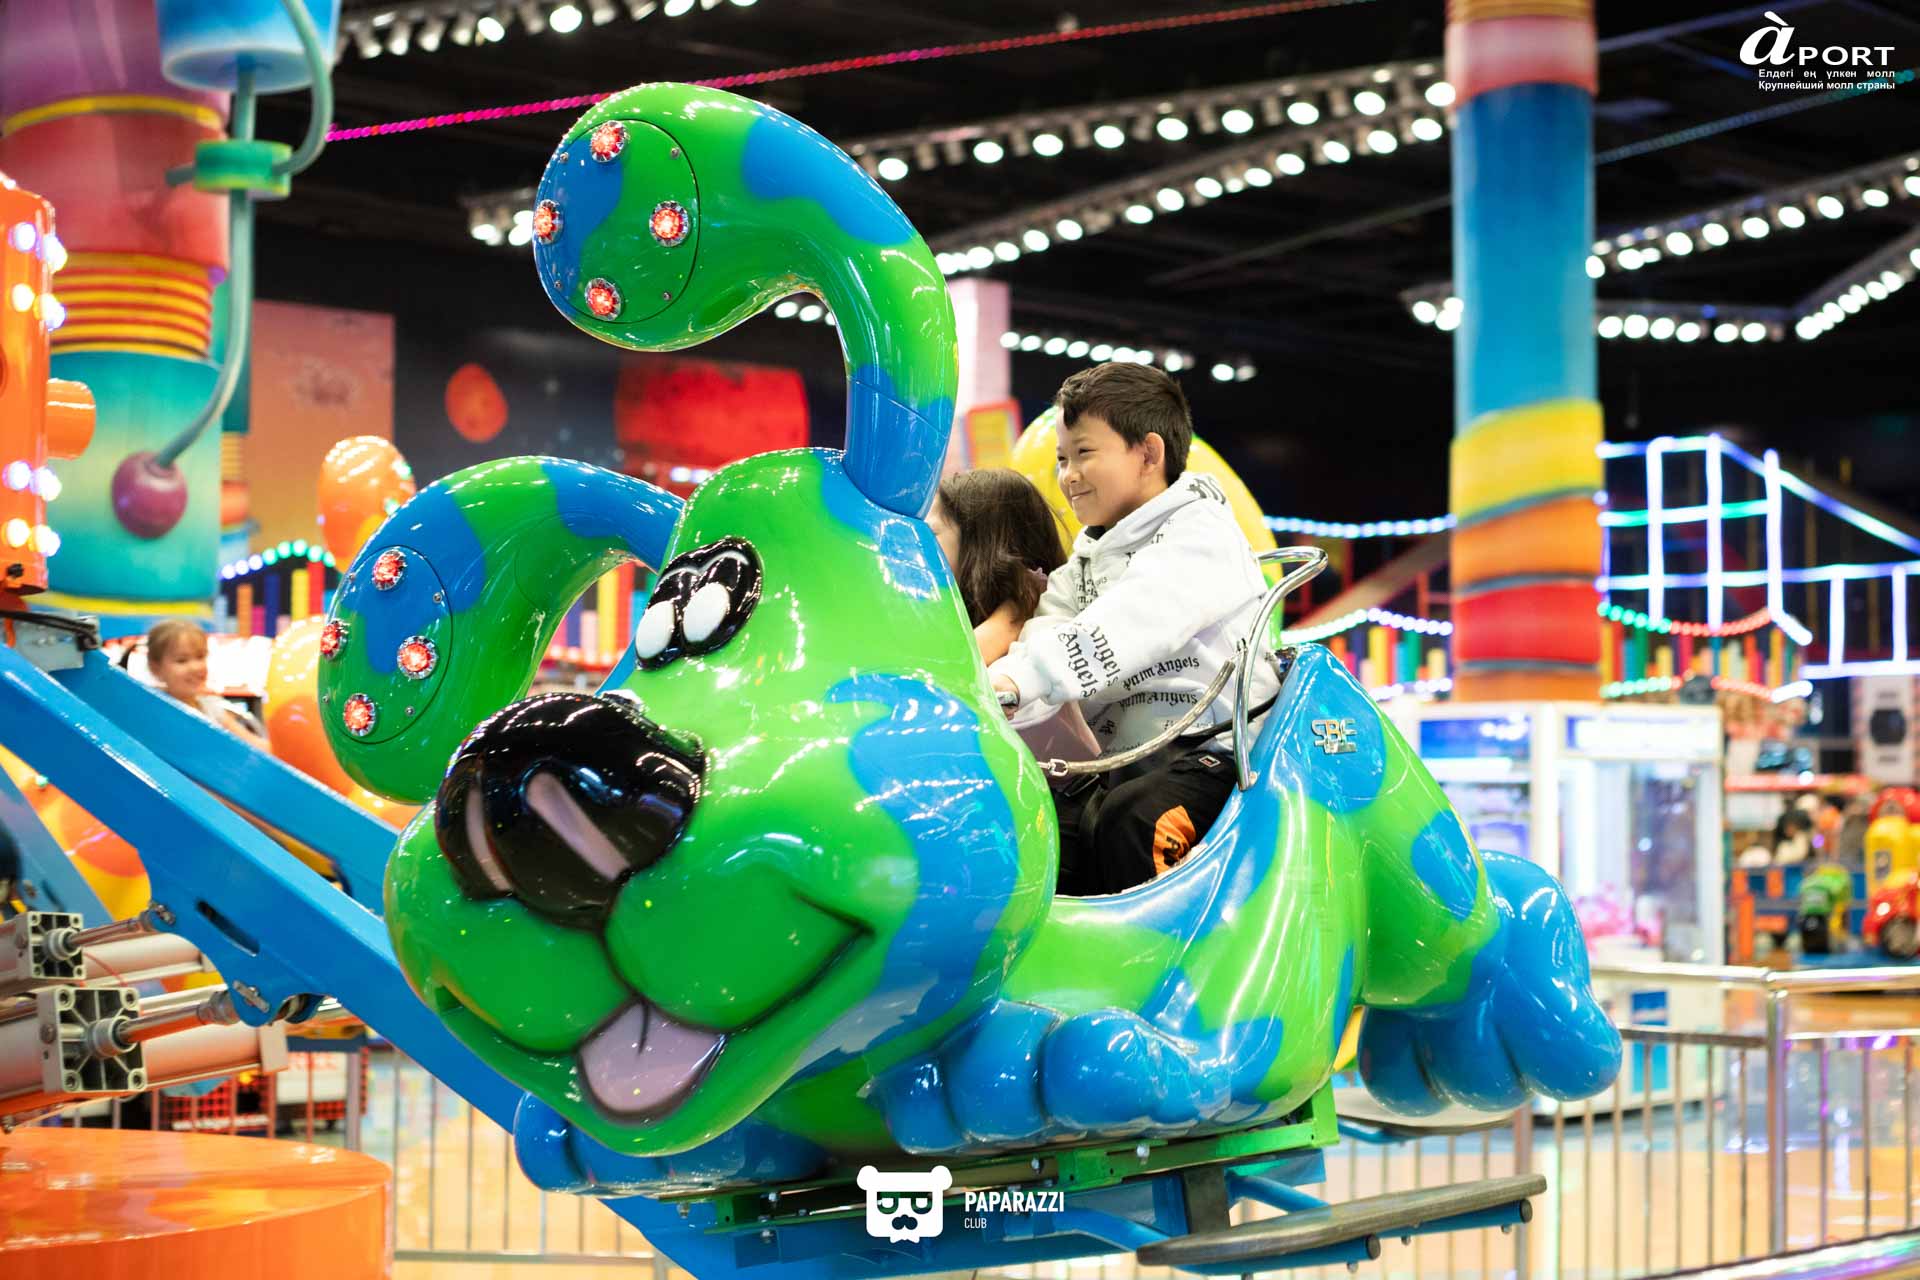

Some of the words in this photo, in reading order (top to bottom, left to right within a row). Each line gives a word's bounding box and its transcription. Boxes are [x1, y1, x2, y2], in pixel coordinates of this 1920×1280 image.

[1058, 628, 1098, 697] Angels
[1155, 656, 1200, 677] Angels
[1147, 691, 1198, 707] Angels
